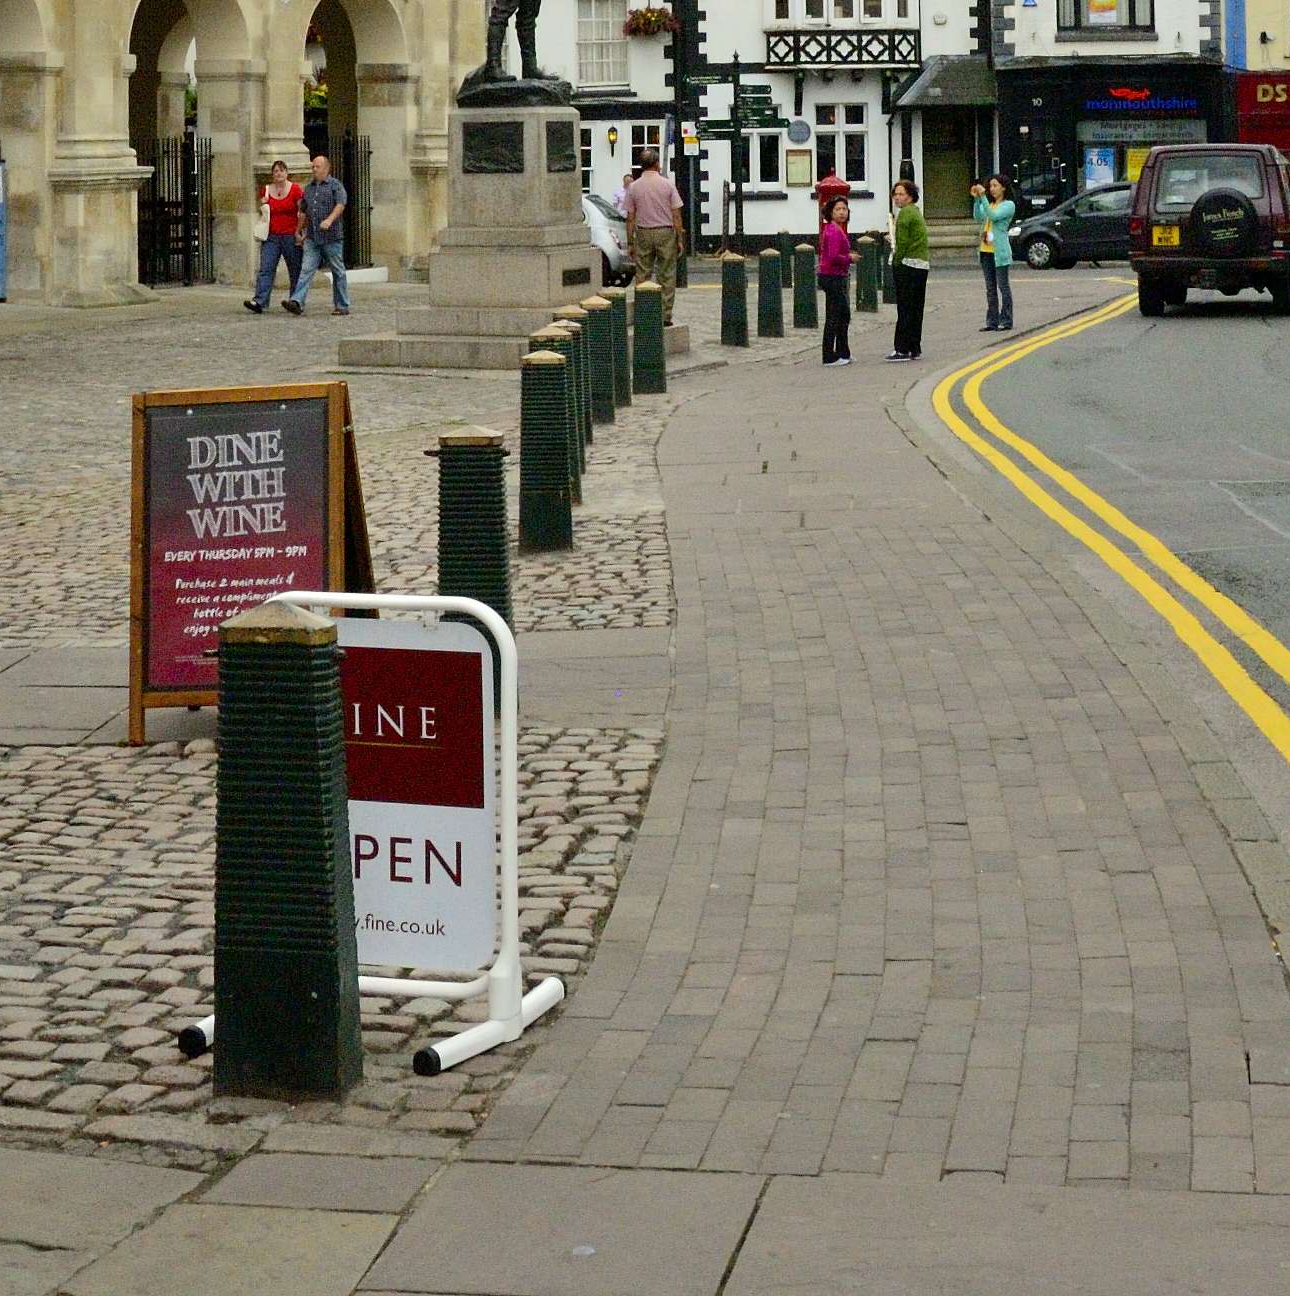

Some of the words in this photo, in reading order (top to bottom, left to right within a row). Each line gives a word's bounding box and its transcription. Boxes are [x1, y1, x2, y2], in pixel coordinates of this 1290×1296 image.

[1257, 85, 1288, 103] DS
[186, 429, 285, 470] DINE
[186, 467, 287, 504] WITH
[186, 501, 287, 540] WINE
[164, 550, 196, 563] EVERY
[198, 548, 253, 562] THURSDAY
[254, 546, 275, 559] 5PM
[285, 545, 307, 558] 9PM
[175, 578, 216, 589] Purchase
[230, 577, 254, 588] main
[176, 595, 210, 605] receive
[193, 607, 223, 620] bottle
[226, 606, 239, 618] of
[183, 624, 210, 638] enjoy
[352, 702, 438, 740] INE
[354, 834, 463, 888] PEN
